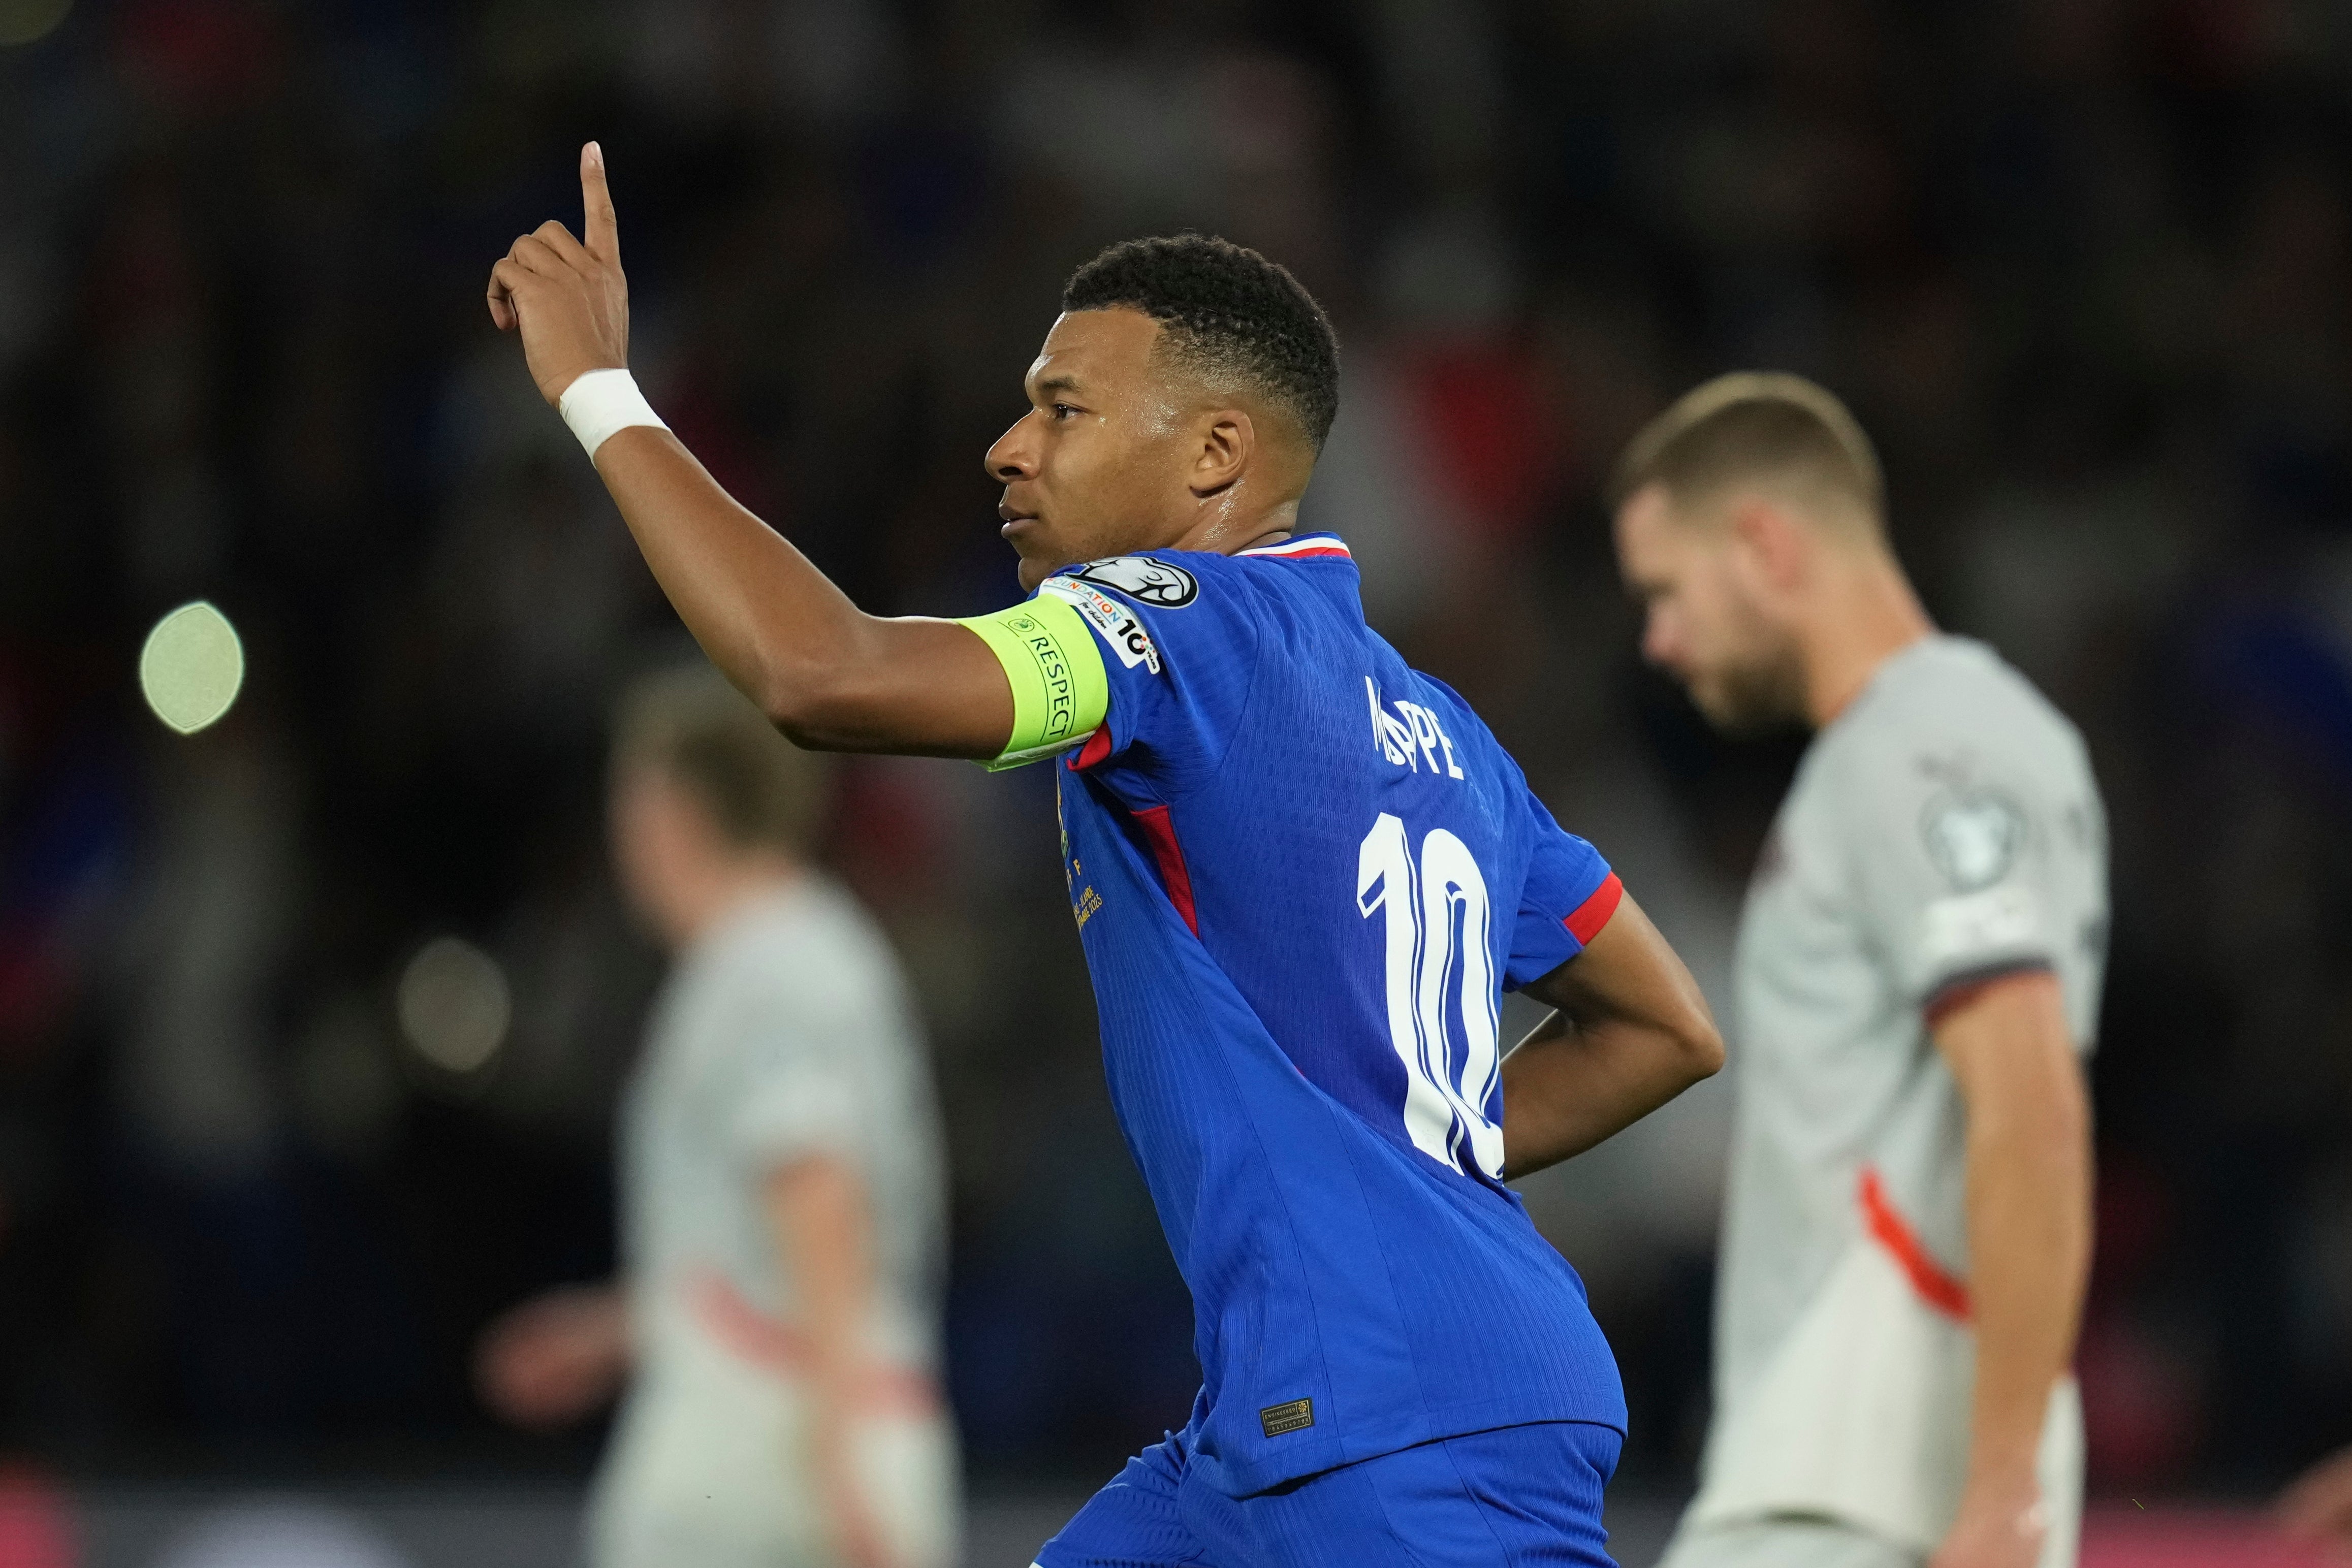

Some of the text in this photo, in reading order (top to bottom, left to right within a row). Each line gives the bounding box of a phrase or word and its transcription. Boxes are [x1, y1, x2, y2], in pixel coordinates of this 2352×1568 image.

[1046, 578, 1121, 622] FOUNDATION
[1088, 610, 1107, 629] children
[1118, 619, 1146, 655] 10
[1147, 651, 1157, 669] YEARS
[1030, 637, 1069, 736] RESPECT
[1089, 893, 1102, 915] 2025
[1356, 812, 1505, 1187] 10
